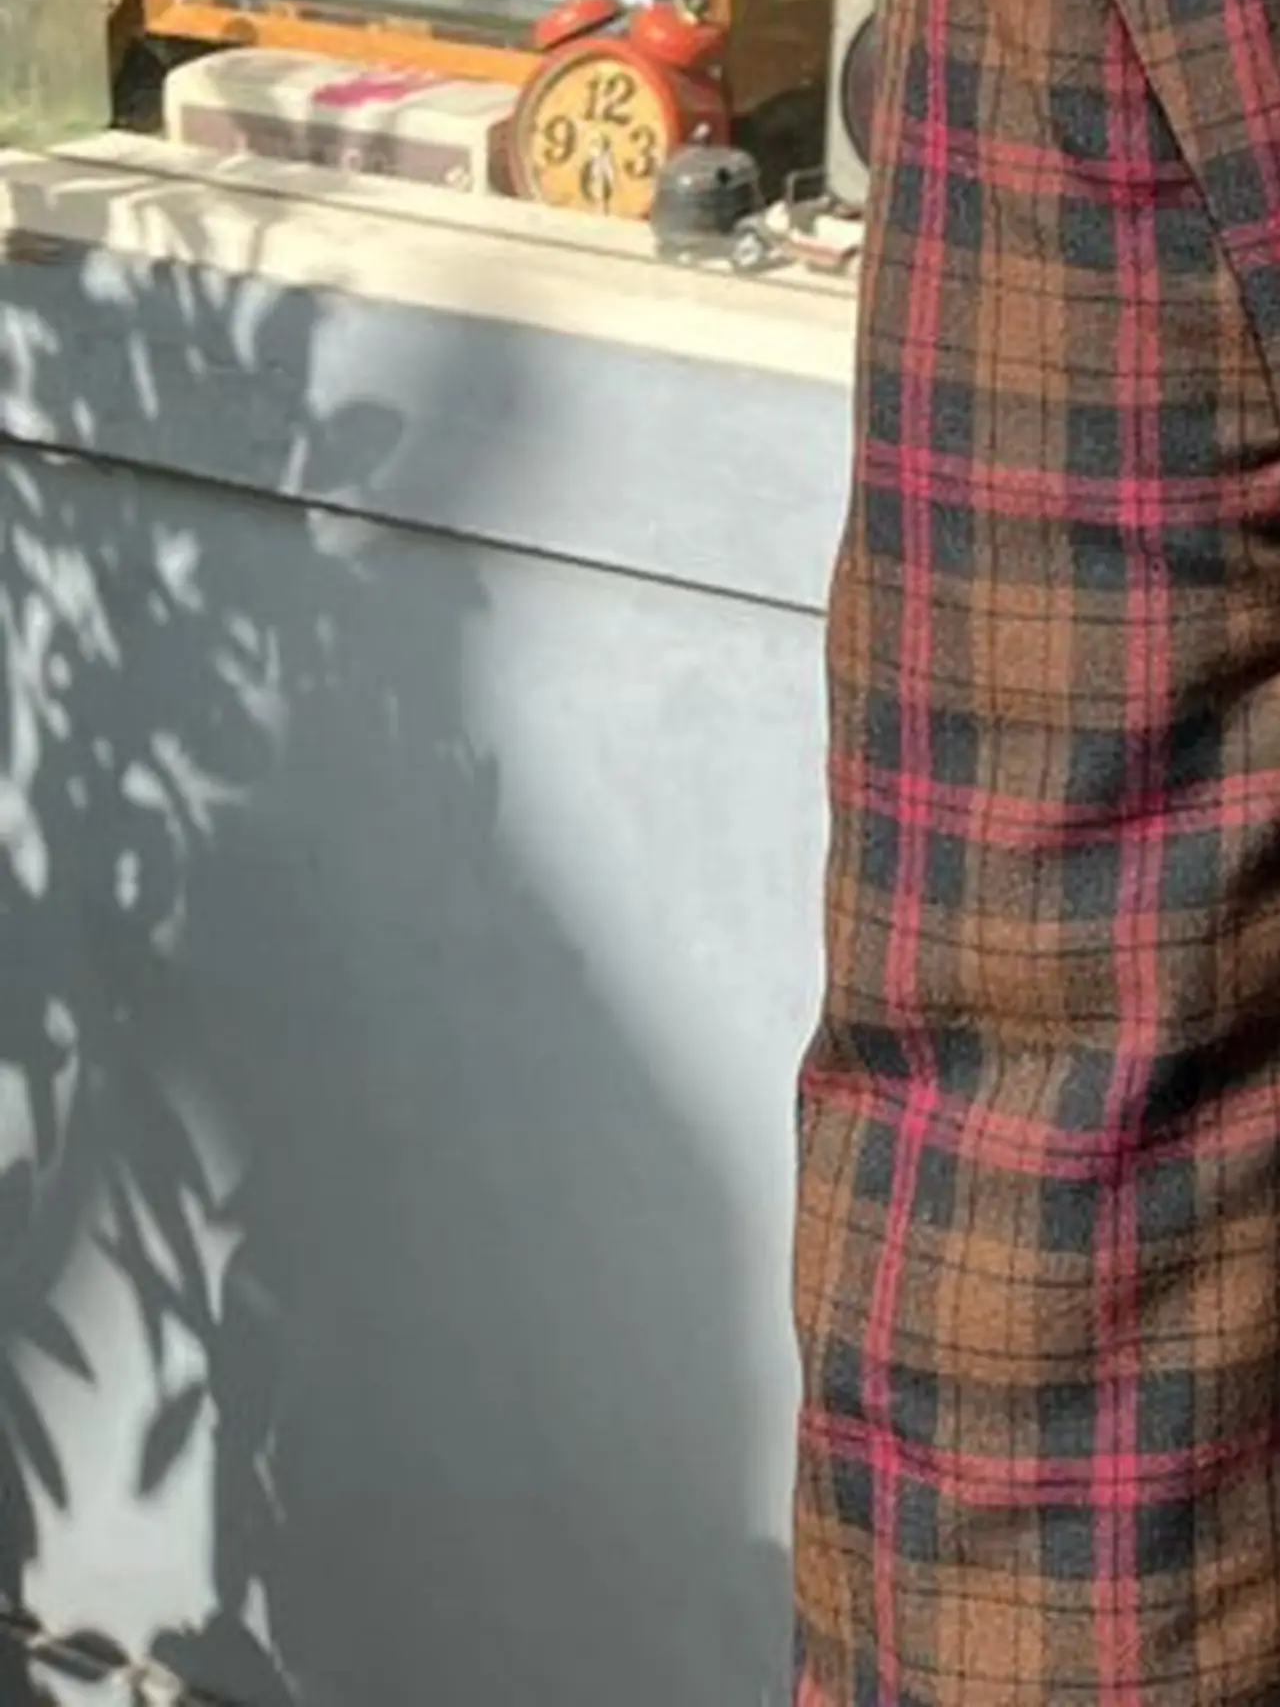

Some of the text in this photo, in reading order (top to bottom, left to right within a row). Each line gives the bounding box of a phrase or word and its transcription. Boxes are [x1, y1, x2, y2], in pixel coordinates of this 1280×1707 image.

[582, 74, 635, 124] 12
[543, 115, 576, 166] 9
[624, 126, 656, 180] 3
